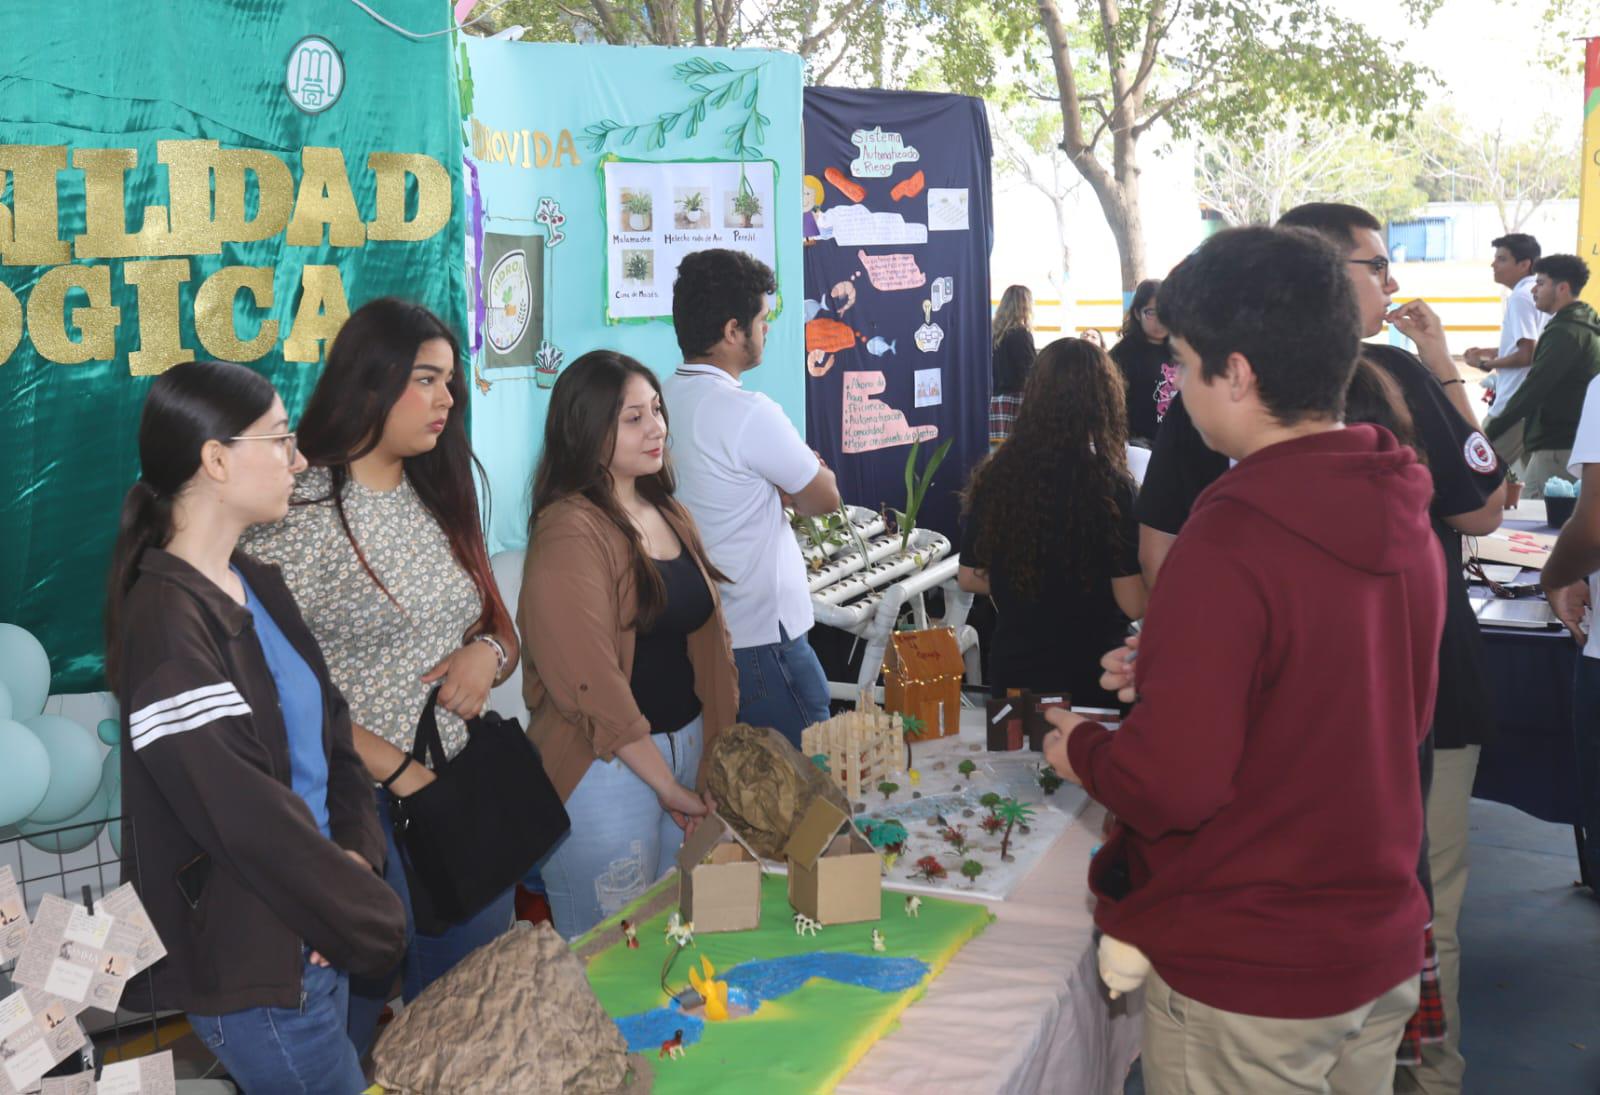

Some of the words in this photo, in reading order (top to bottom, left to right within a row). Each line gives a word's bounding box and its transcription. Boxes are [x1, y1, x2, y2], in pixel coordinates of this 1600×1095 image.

[853, 126, 901, 144] Sistema
[862, 143, 919, 161] Automatizado
[863, 160, 891, 176] Riego
[0, 140, 451, 266] ILIDAD
